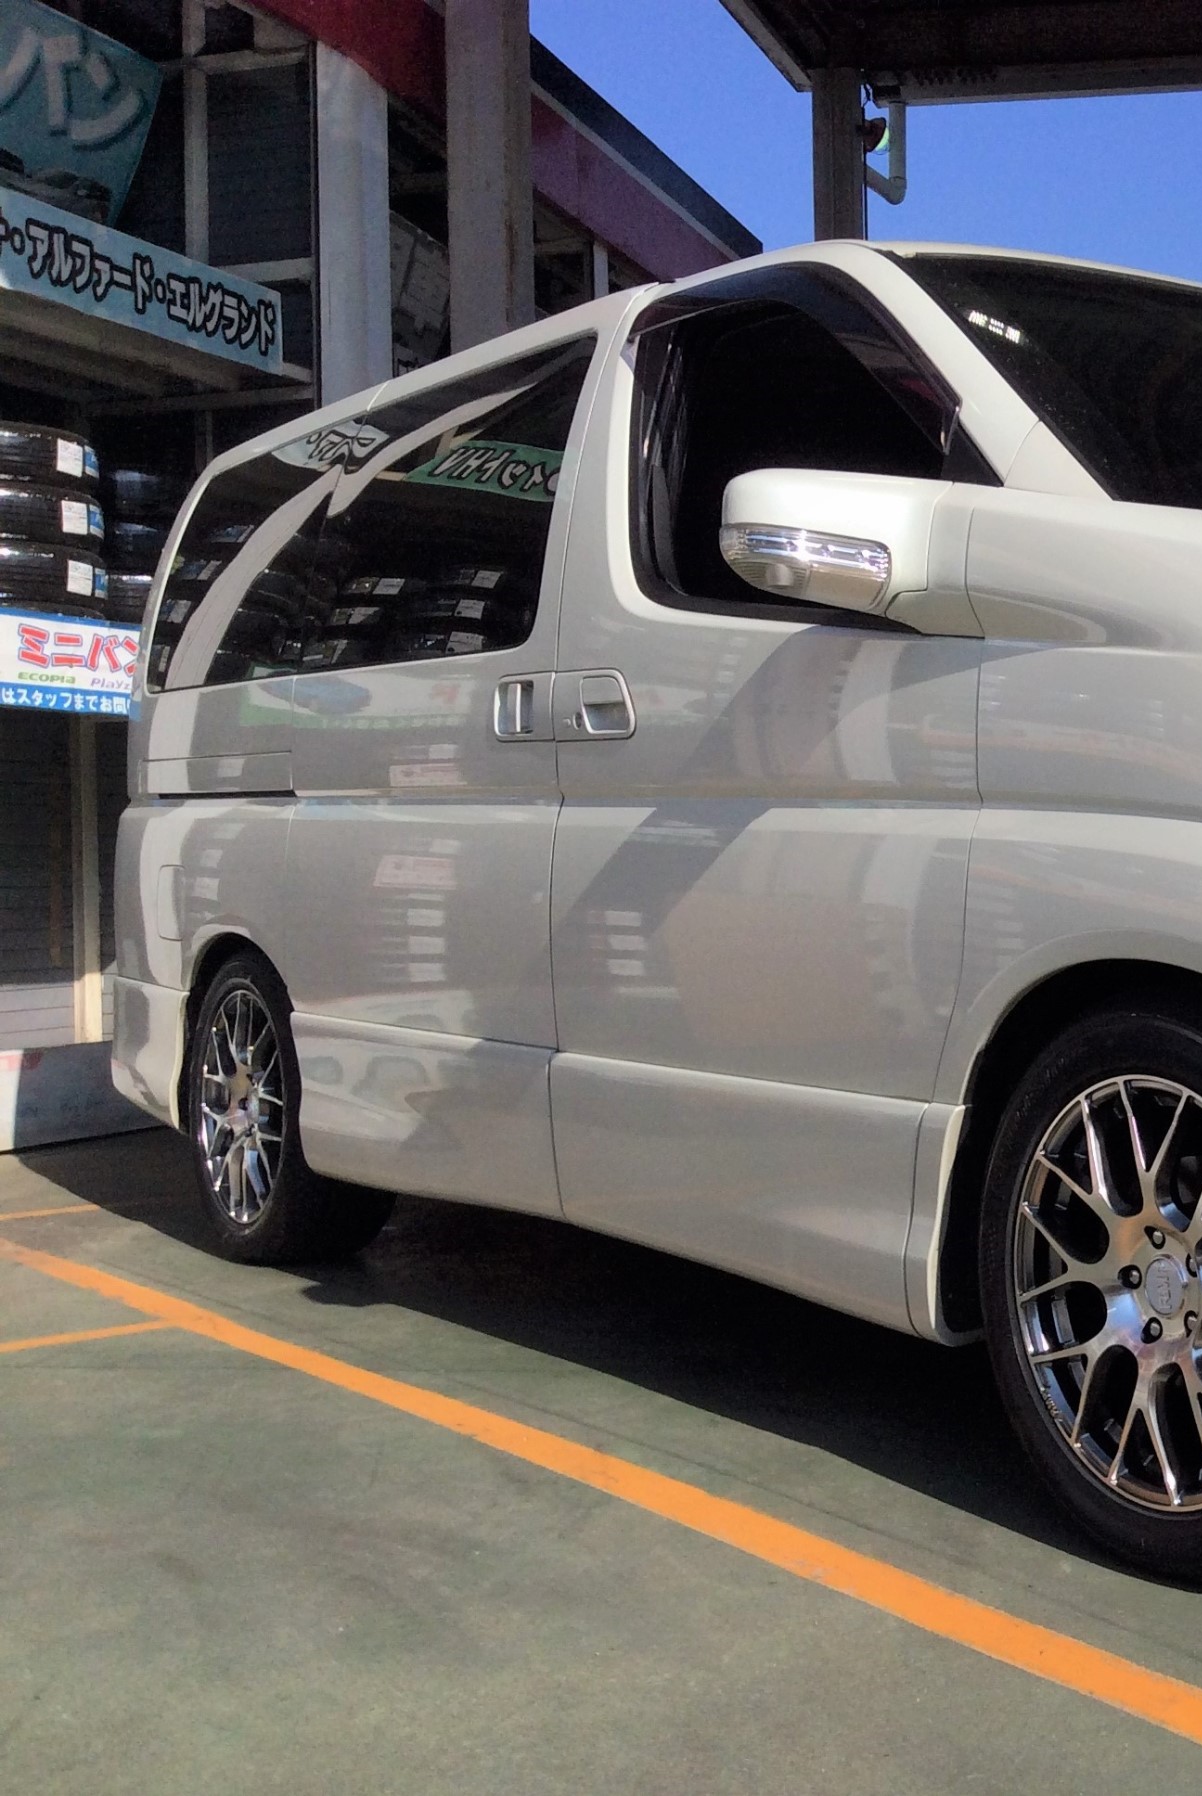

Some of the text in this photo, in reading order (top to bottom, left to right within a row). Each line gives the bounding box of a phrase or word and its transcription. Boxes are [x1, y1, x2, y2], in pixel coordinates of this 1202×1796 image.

[0, 206, 276, 356] ・アルファード・エルグランド
